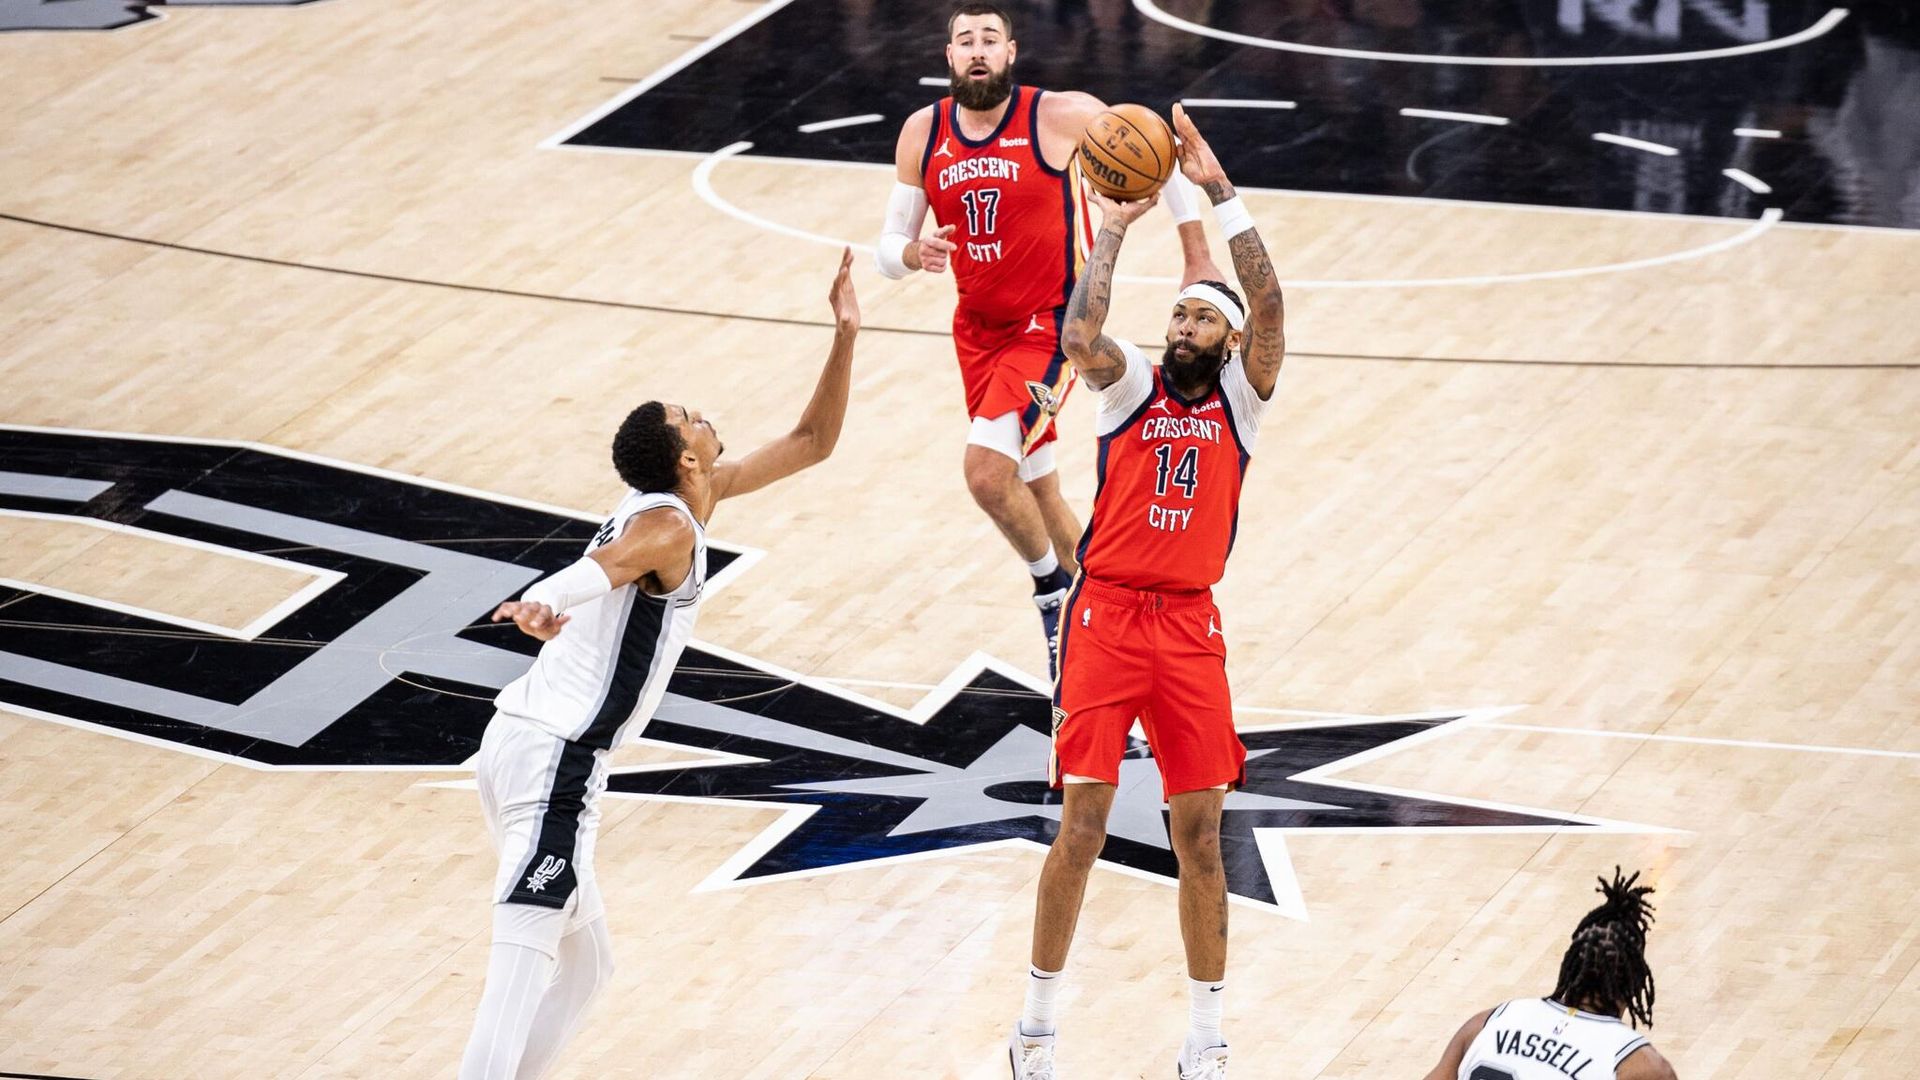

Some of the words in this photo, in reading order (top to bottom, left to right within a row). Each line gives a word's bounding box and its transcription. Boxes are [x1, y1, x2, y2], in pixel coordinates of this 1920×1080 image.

[999, 137, 1029, 148] ibotta
[939, 157, 1020, 190] CRESCENT
[961, 188, 1001, 236] 17
[967, 240, 1002, 262] CITY
[1191, 400, 1222, 415] ibotta
[1142, 416, 1222, 444] CRESCENT
[1155, 444, 1199, 499] 14
[1148, 504, 1194, 532] CITY
[1496, 1029, 1593, 1080] VASSELL
